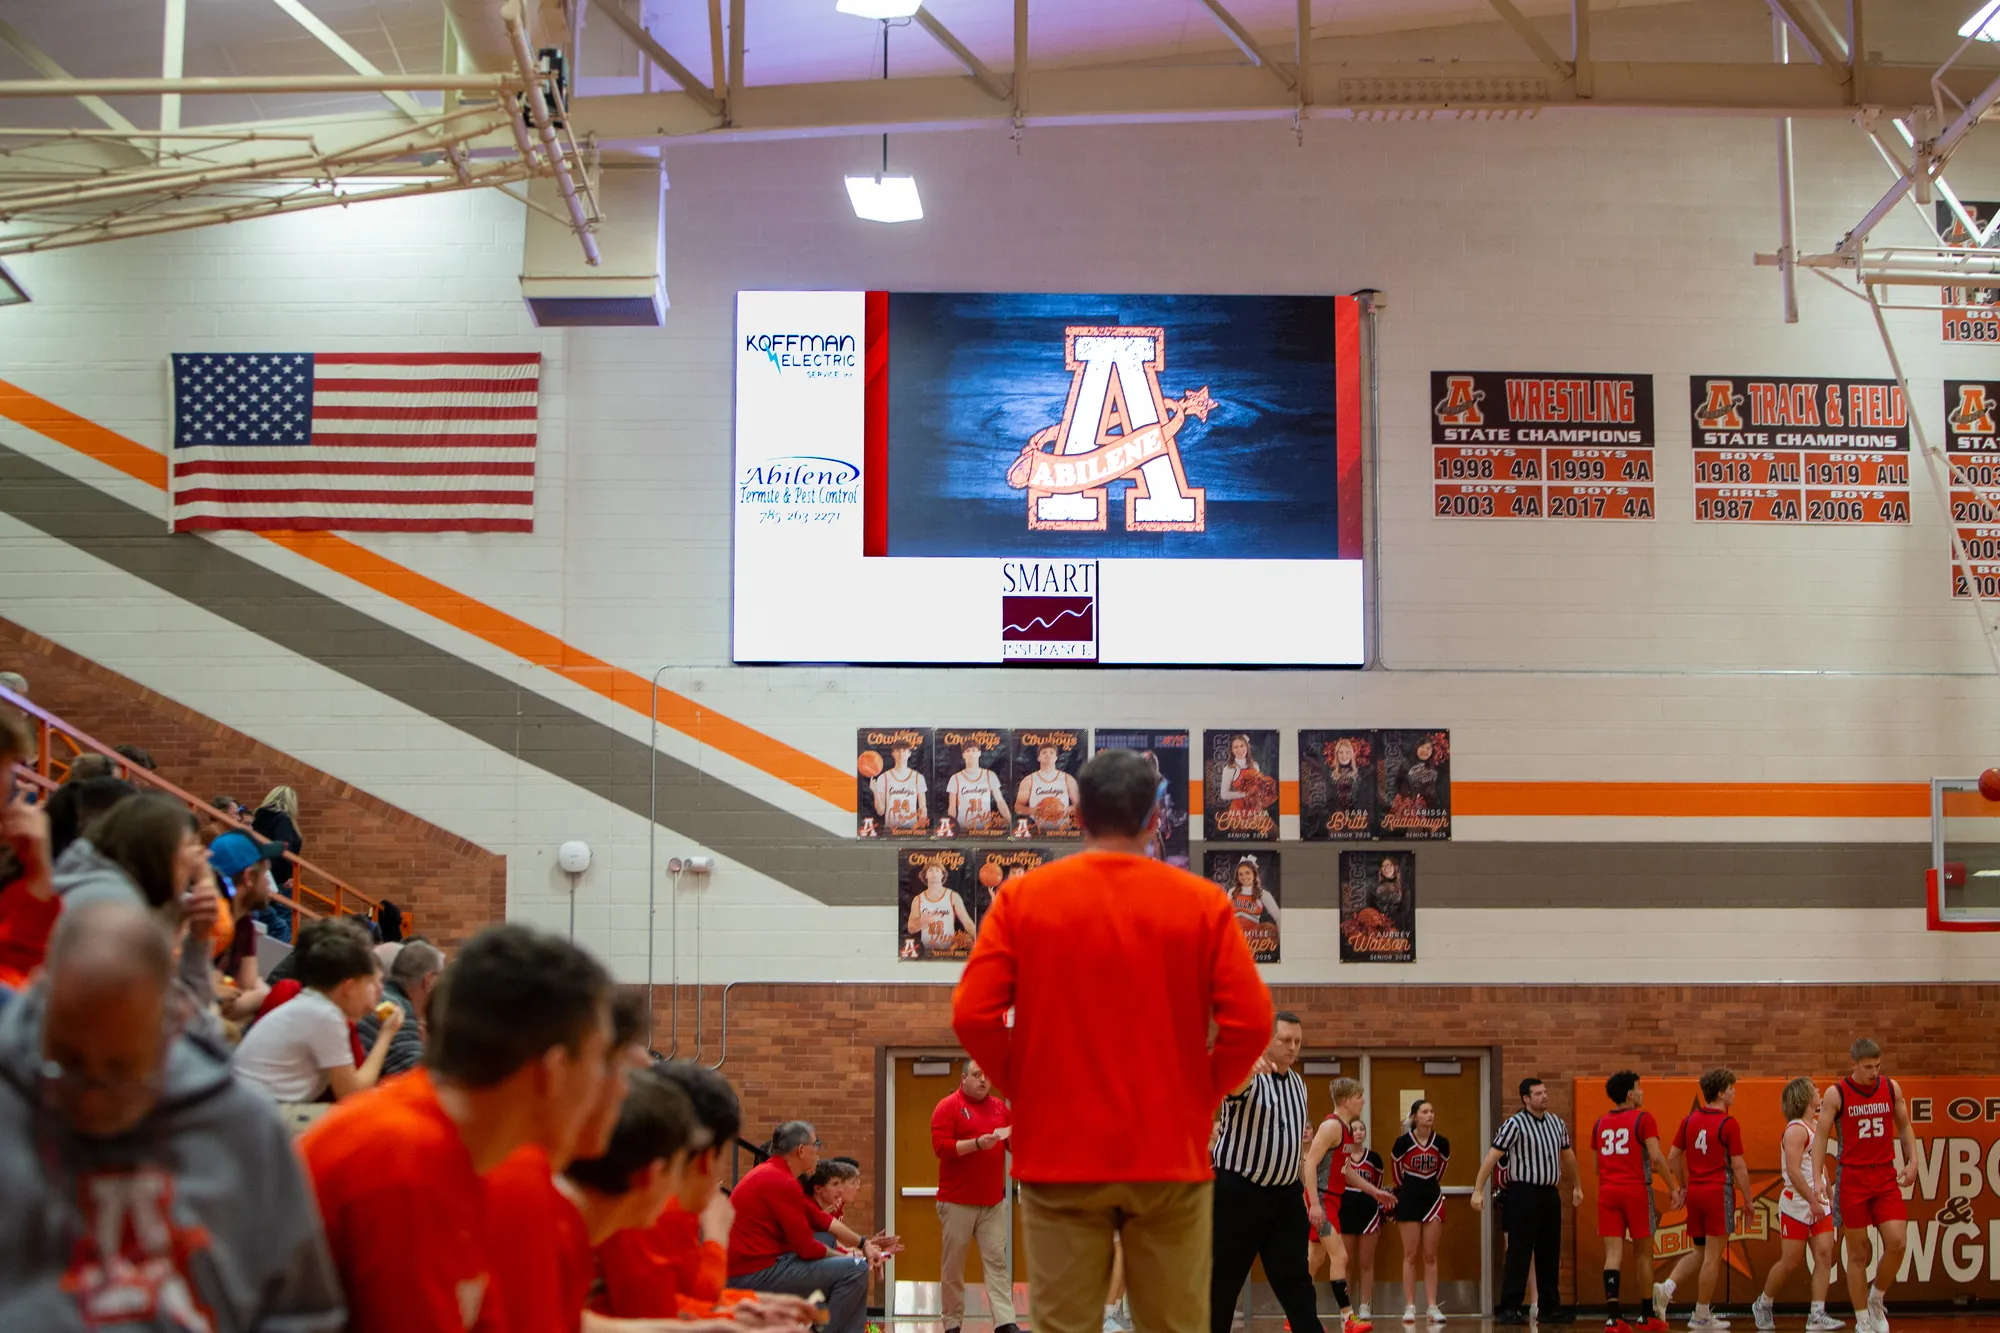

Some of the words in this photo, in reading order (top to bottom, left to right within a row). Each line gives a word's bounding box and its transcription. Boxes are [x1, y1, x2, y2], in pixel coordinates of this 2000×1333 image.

[1946, 320, 1999, 340] 1985
[746, 334, 855, 352] KOFFMAN
[781, 354, 855, 367] ELECTRIC
[1505, 379, 1635, 423] WRESTLING
[1748, 383, 1821, 426] TRACK
[1826, 385, 1844, 427] &
[1848, 385, 1908, 427] FIELD
[1444, 428, 1511, 441] STATE
[1517, 429, 1642, 443] CHAMPIONS
[1704, 433, 1769, 445] STATE
[1775, 434, 1898, 448] CHAMPIONS
[1957, 437, 2000, 450] STA
[1031, 427, 1162, 487] ABILENE
[1460, 448, 1517, 457] BOYS
[1572, 449, 1628, 458] BOYS
[1720, 452, 1776, 461] BOYS
[1829, 454, 1884, 462] BOYS
[739, 464, 849, 485] Abilene
[1438, 458, 1494, 479] 1998
[1510, 459, 1540, 480] 4A
[1550, 460, 1605, 480] 1999
[1621, 460, 1651, 480] 4A
[1697, 462, 1752, 482] 1918
[1768, 463, 1800, 483] ALL
[1807, 464, 1861, 484] 1919
[1877, 465, 1909, 485] ALL
[740, 486, 779, 503] Termite
[783, 487, 791, 503] &
[795, 486, 815, 503] Pest
[819, 484, 859, 503] Control
[1460, 485, 1517, 494] BOYS
[1573, 486, 1630, 495] BOYS
[1718, 489, 1779, 498] GIRLS
[1830, 490, 1885, 500] BOYS
[1438, 496, 1495, 517] 2003
[1511, 497, 1541, 517] 4A
[1551, 497, 1607, 518] 2017
[1623, 498, 1653, 518] 4A
[1700, 500, 1753, 520] 1987
[1771, 500, 1799, 520] 4A
[1809, 501, 1863, 521] 2006
[1880, 501, 1908, 522] 4A
[1953, 502, 2000, 523] 200
[1003, 563, 1094, 592] SMART
[1956, 576, 2000, 597] 200
[1348, 932, 1411, 952] Watson
[1848, 1102, 1890, 1117] CONCORDIA
[1858, 1117, 1885, 1139] 25
[1601, 1128, 1629, 1156] 32
[1695, 1129, 1708, 1155] 4
[1411, 1153, 1438, 1173] CHS
[1936, 1196, 1973, 1227] &
